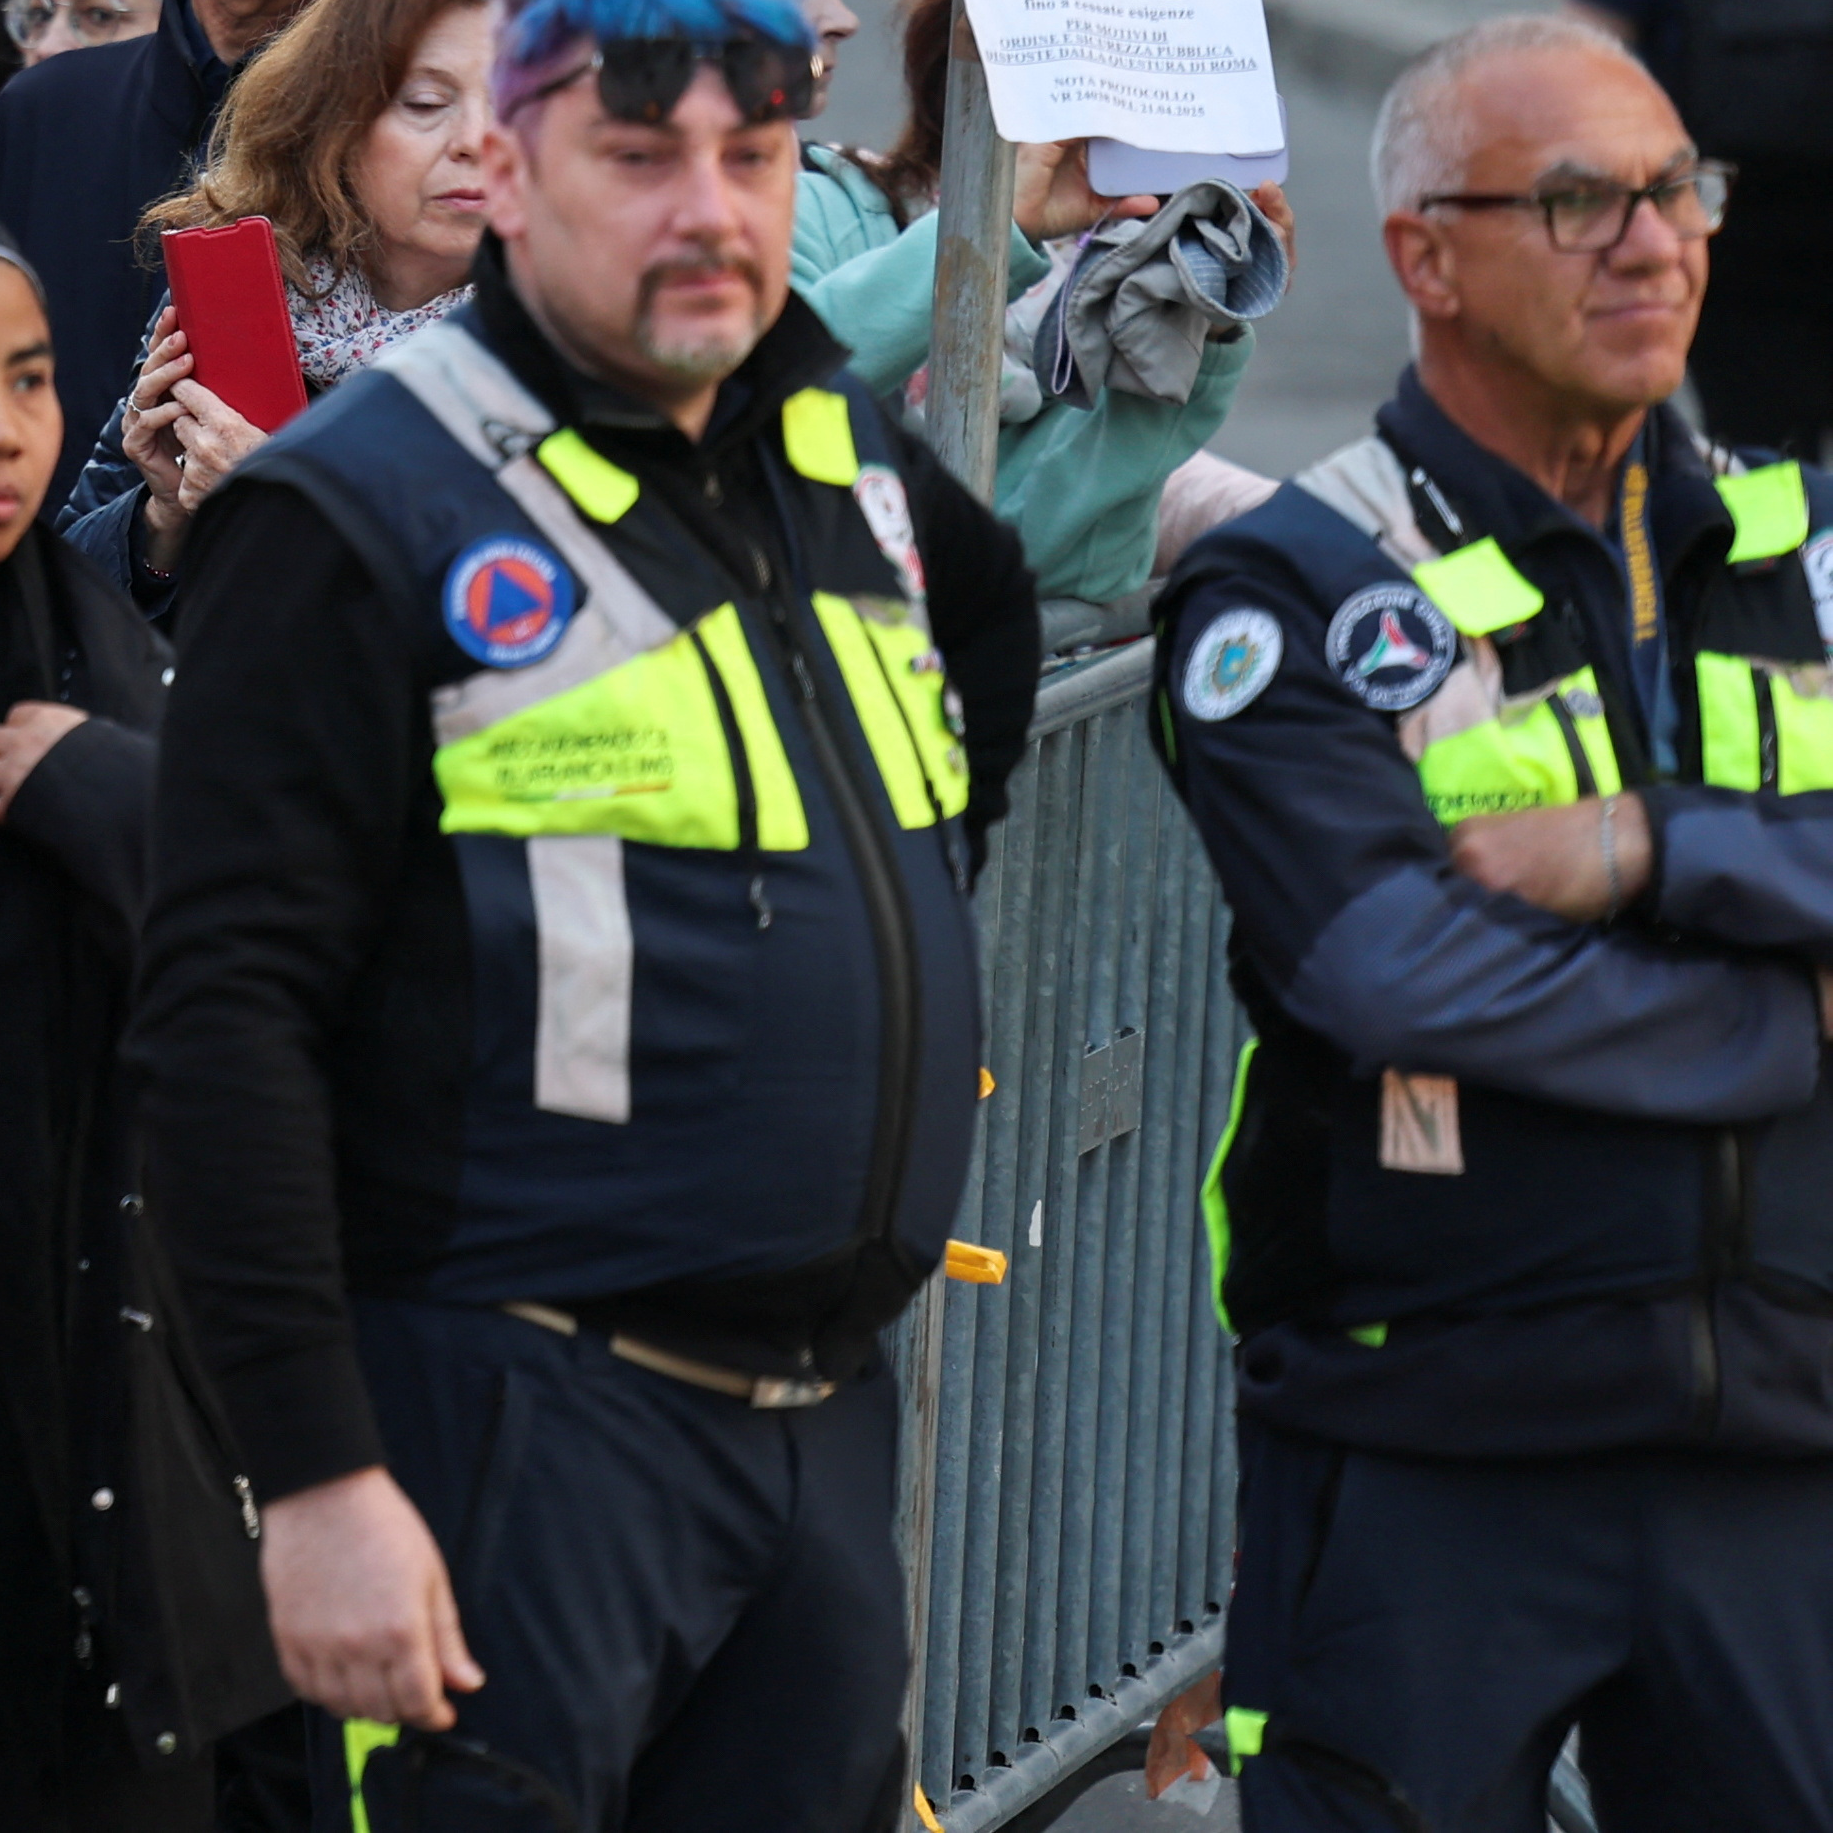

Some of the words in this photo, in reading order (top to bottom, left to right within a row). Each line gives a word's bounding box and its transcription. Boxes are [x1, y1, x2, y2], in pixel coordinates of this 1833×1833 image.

[1025, 0, 1056, 11] fino
[1129, 8, 1196, 22] esigenze
[1066, 19, 1093, 32] PER
[1095, 23, 1148, 42] MOTIVI
[1152, 30, 1169, 43] DI
[1000, 33, 1057, 50] ORDINE
[1063, 32, 1074, 45] E
[1076, 34, 1153, 57] SICUREZZA
[1157, 45, 1234, 59] PUBBLICA
[986, 49, 1056, 64] DISPOSTE
[1189, 61, 1207, 73] DI
[1209, 57, 1259, 72] ROMA
